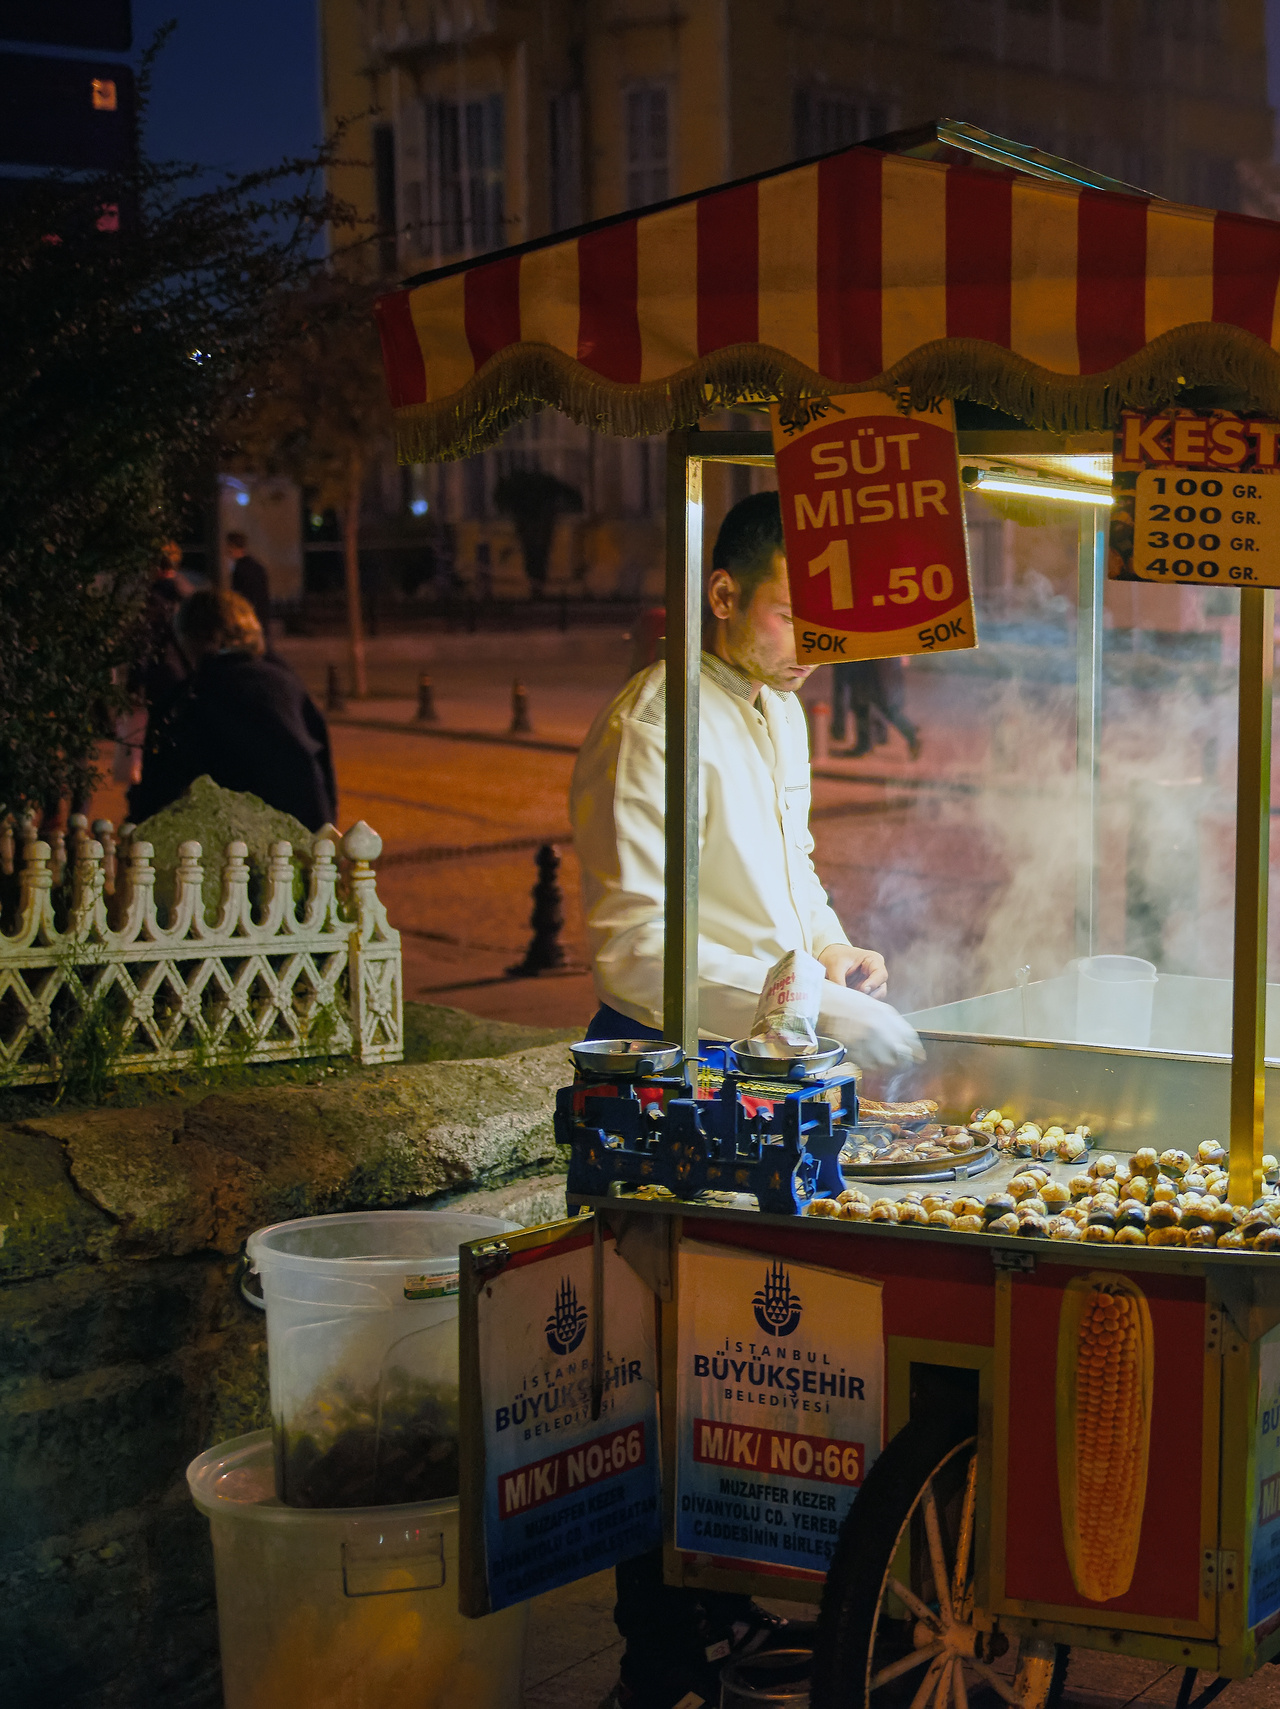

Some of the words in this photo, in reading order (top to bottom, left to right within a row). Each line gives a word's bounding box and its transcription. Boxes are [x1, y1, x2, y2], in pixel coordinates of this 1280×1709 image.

[810, 428, 919, 480] SÜT
[794, 479, 949, 530] MISIR
[1152, 477, 1223, 497] 100
[1232, 485, 1262, 499] GR.
[1148, 504, 1222, 524] 200
[1231, 511, 1261, 525] GR.
[1147, 531, 1221, 551] 300
[1230, 537, 1259, 552] GR.
[1145, 558, 1219, 578] 400
[1228, 566, 1258, 581] GR.
[801, 631, 848, 653] ŞOK
[918, 617, 966, 649] ŞOK
[725, 1337, 830, 1365] İSTANBUL
[523, 1351, 613, 1391] İSTANBL
[693, 1350, 865, 1400] BÜYÜKŞEHİR
[496, 1357, 643, 1432] BÜYÜKŞHİR
[724, 1388, 830, 1414] BELEDİYESİ
[524, 1397, 615, 1441] BELEDİYSİ
[567, 1430, 641, 1488] NO:66
[770, 1436, 859, 1481] NO:66
[720, 1478, 788, 1504] MUZAFFER
[793, 1490, 836, 1512] KEZER
[765, 1508, 787, 1526] CD.
[792, 1513, 839, 1535] YEREB
